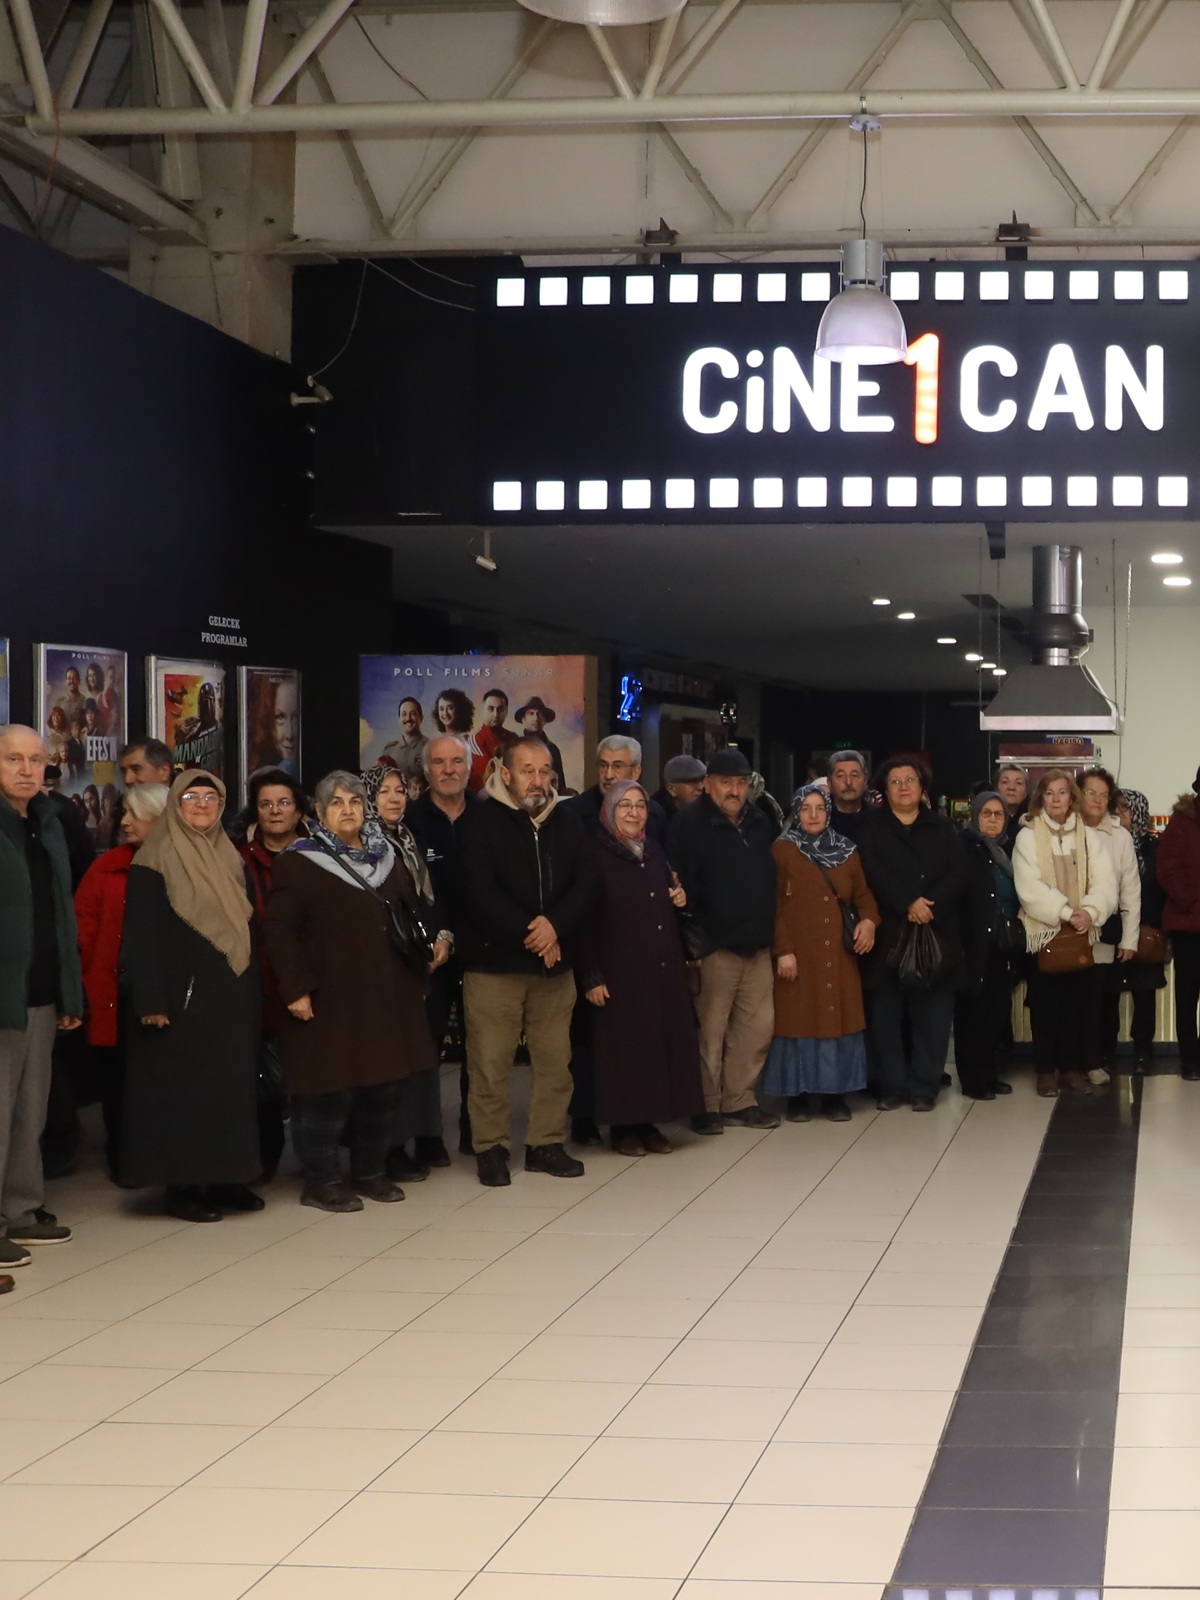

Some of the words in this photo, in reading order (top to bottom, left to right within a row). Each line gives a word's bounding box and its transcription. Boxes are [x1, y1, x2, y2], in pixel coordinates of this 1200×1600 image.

[208, 615, 241, 630] GELECEK
[201, 632, 248, 648] PROGRAMLAR
[71, 652, 90, 660] POLL
[393, 667, 433, 677] POLL
[444, 667, 492, 677] FILMS
[503, 667, 554, 677] SUNAR
[1051, 737, 1084, 745] HARIBO
